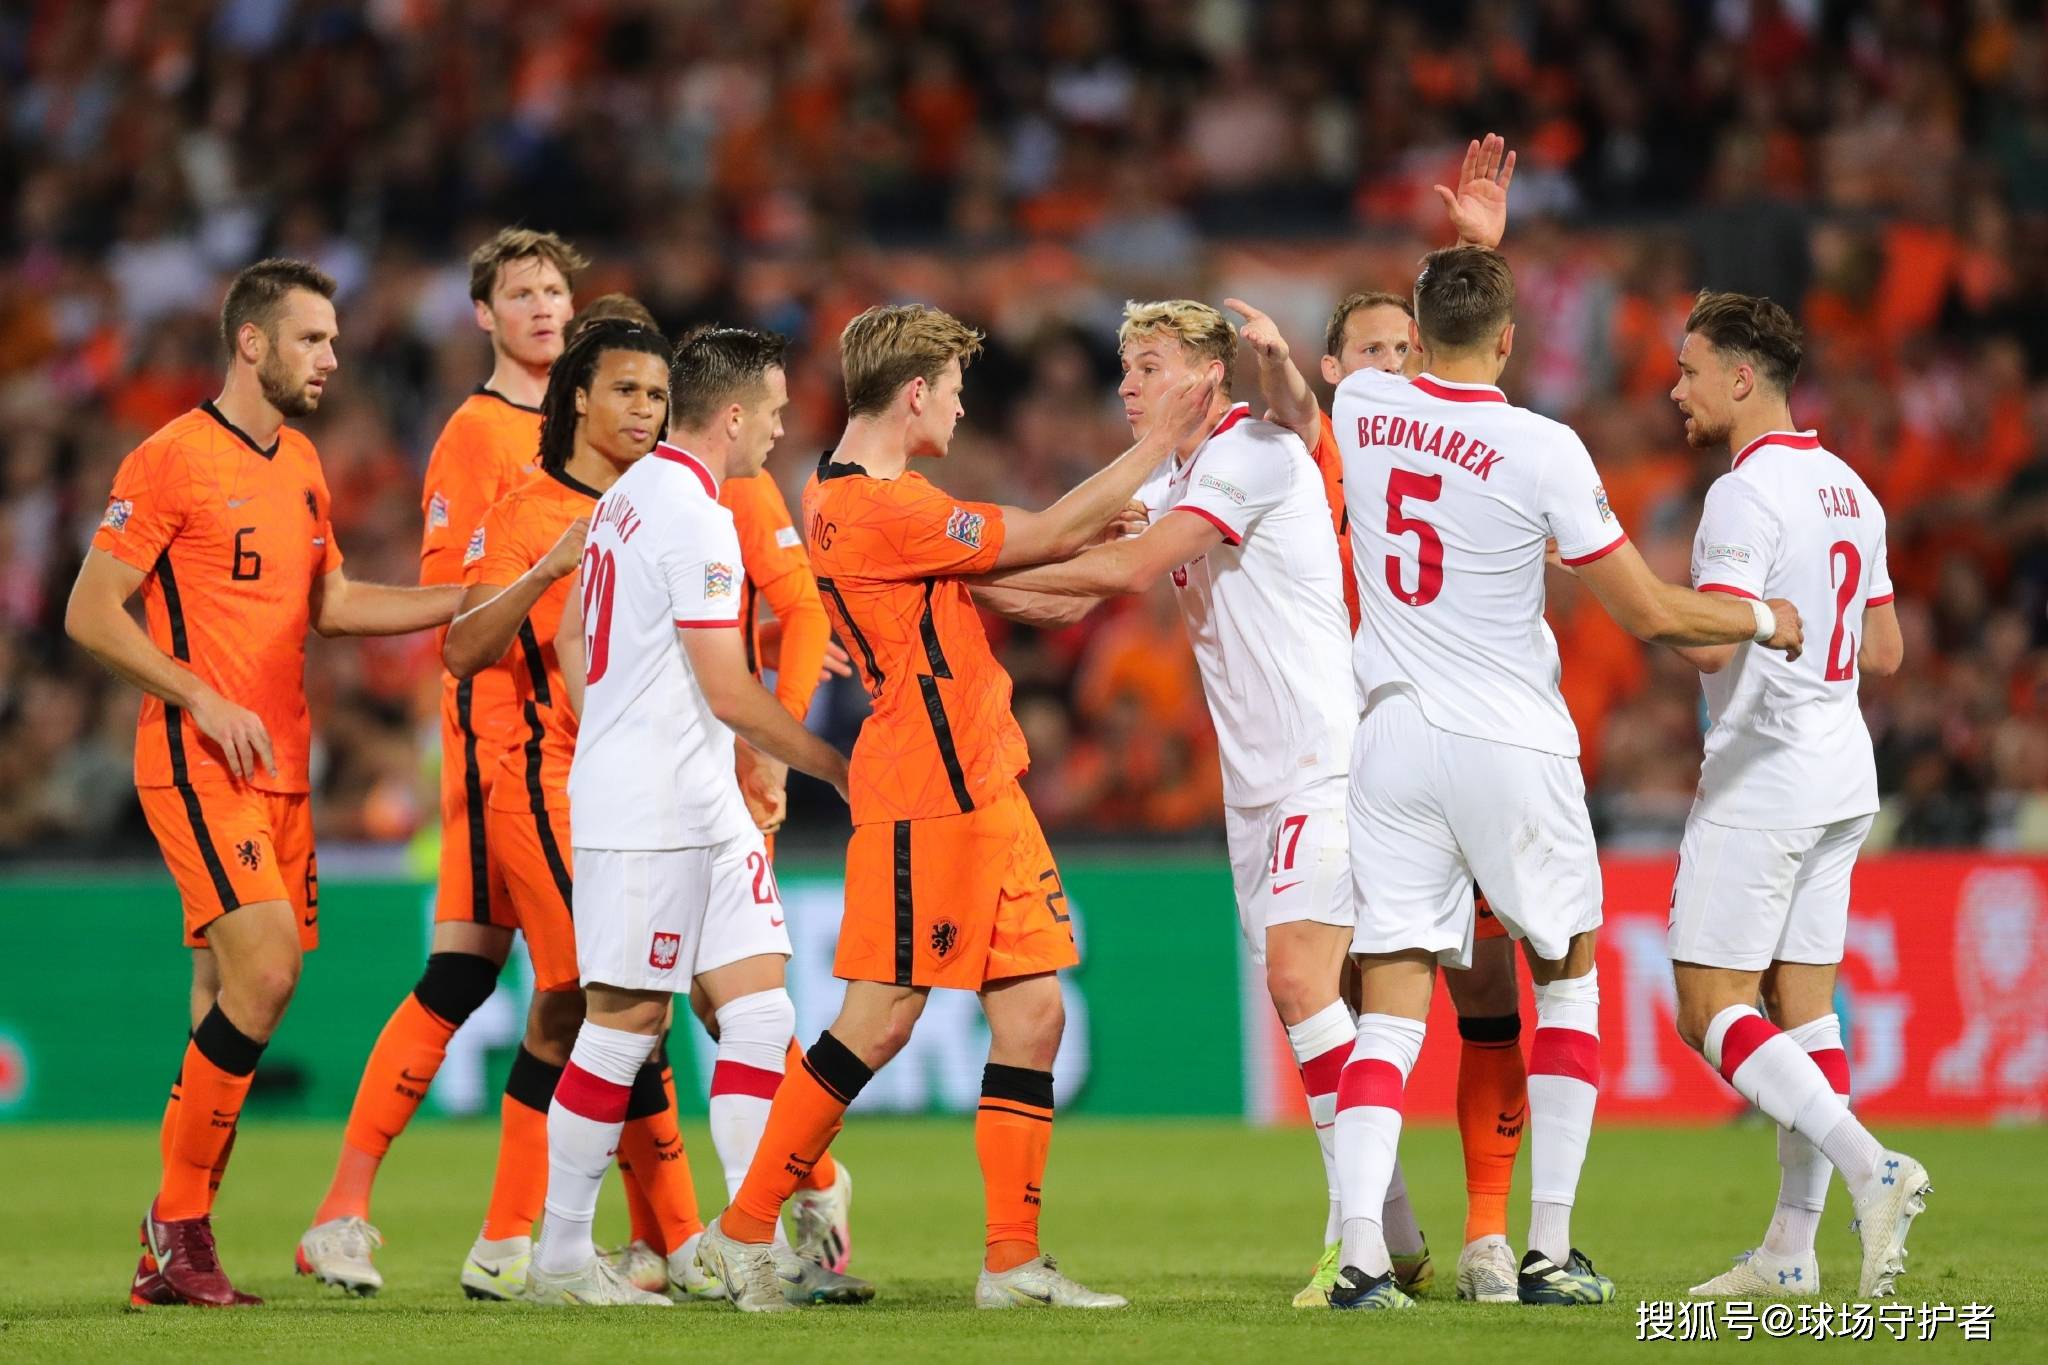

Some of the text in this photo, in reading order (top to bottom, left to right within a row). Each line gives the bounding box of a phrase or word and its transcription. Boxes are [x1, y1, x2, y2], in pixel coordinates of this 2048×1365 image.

[1357, 415, 1504, 482] BEDNAREK
[1818, 486, 1860, 519] CASH
[232, 527, 262, 581] 6
[1385, 467, 1444, 607] 5
[1824, 540, 1862, 682] 2
[1271, 814, 1309, 875] 17
